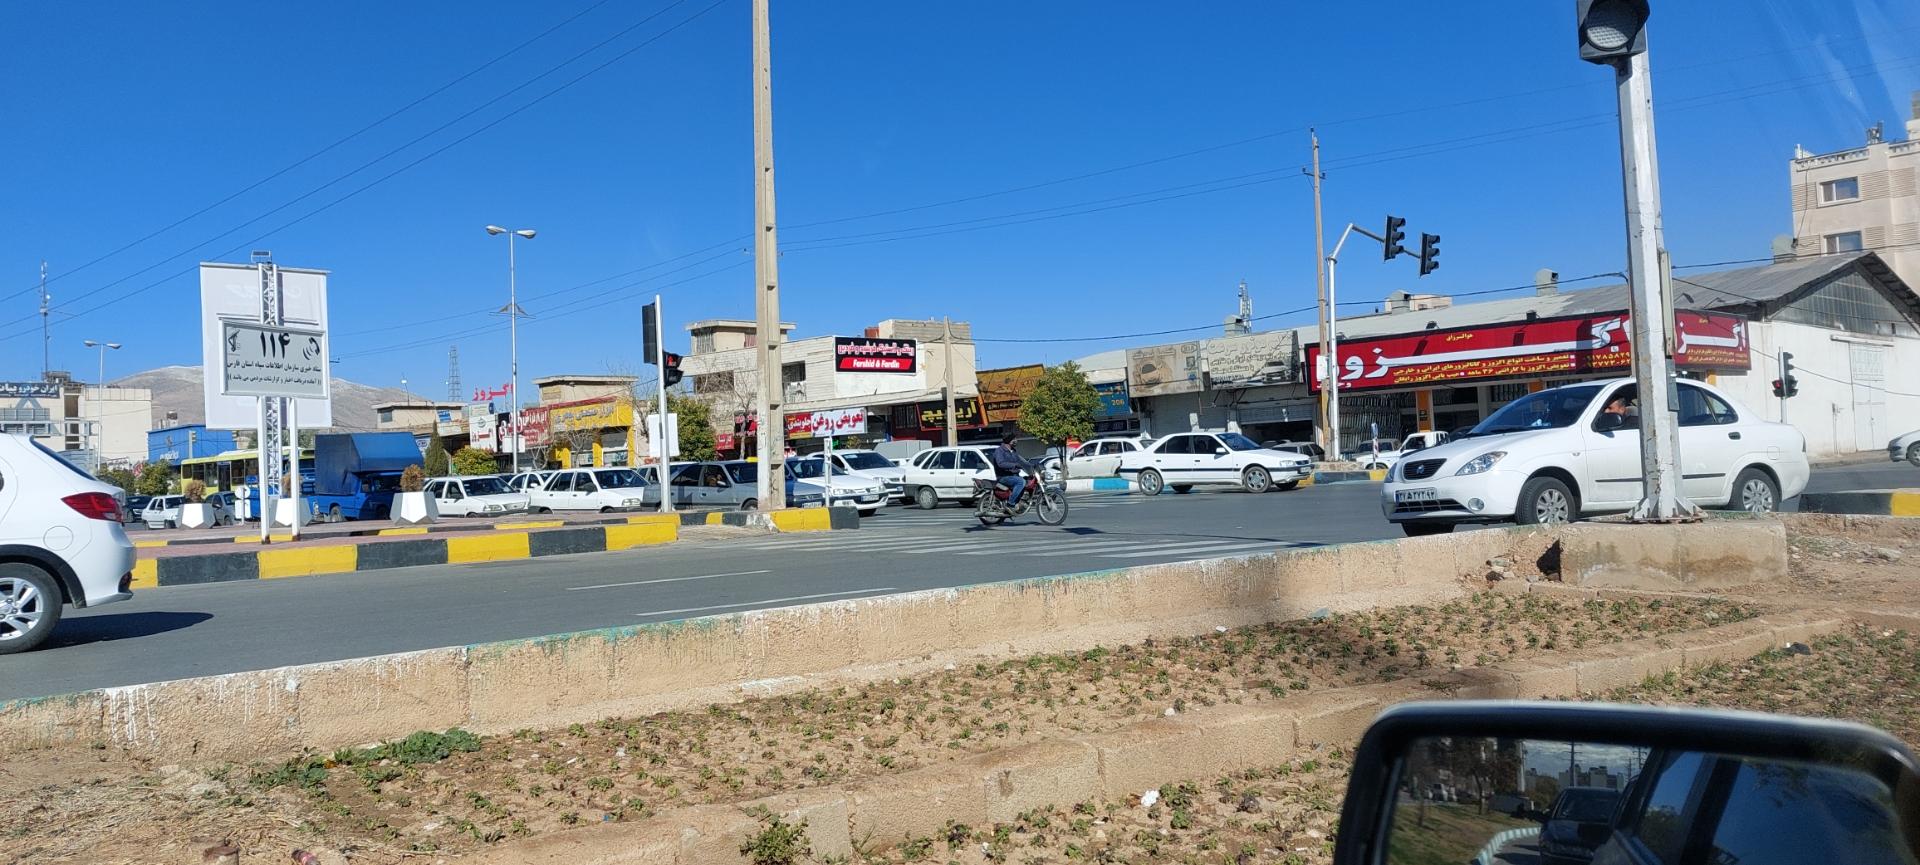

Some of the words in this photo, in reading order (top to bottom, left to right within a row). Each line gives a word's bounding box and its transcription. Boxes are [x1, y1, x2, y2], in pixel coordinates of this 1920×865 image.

[260, 331, 290, 360] ۱۱۴
[853, 359, 875, 368] Farshid
[881, 360, 900, 369] Fardin
[812, 412, 836, 432] روغن
[836, 409, 865, 430] تعویض
